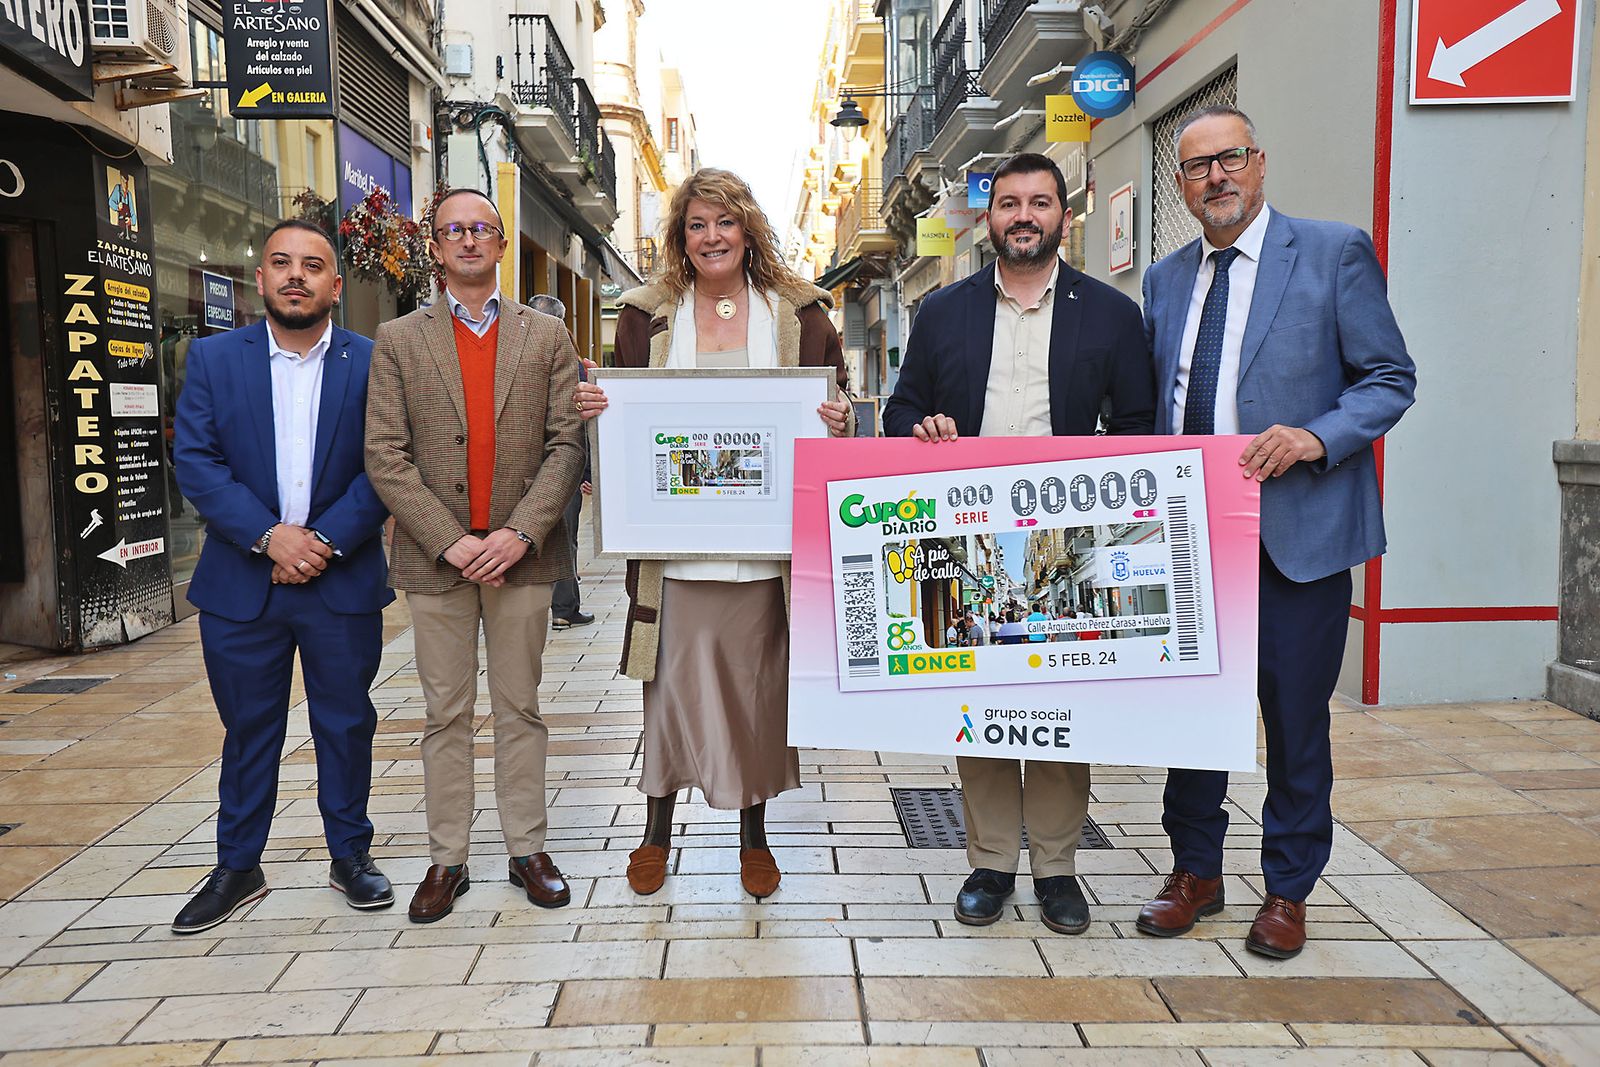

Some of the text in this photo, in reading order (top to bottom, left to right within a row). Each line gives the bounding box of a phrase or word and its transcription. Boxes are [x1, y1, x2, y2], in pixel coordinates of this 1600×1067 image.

[233, 3, 252, 15] EL
[233, 14, 321, 33] ARTESANO
[246, 37, 310, 50] Arreglo y venta
[255, 51, 303, 61] del calzado
[246, 64, 313, 77] Artículos en piel
[1073, 78, 1130, 93] DIGI
[271, 92, 327, 103] EN GALERIA
[1052, 113, 1087, 123] Jazztel
[344, 160, 368, 191] Maribel
[96, 239, 149, 261] ZAPATERO
[87, 250, 152, 277] EL ARTESANO
[209, 281, 228, 297] PRECIOS
[207, 306, 233, 322] ESPECIALES
[63, 273, 109, 494] ZAPATERO
[692, 432, 708, 441] 000
[713, 432, 761, 446] 00000
[947, 465, 1193, 517] 000 00000 2€
[954, 510, 989, 525] SERIE
[119, 541, 159, 559] EN INTERIOR
[911, 545, 949, 566] A pie
[913, 562, 964, 582] de calle
[1133, 567, 1166, 577] HUELVA
[1027, 615, 1171, 633] Calle Arquitecto Pérez Carasa Huelva
[887, 620, 916, 651] 85
[913, 653, 971, 671] ONCE
[1048, 651, 1118, 668] 5 FEB. 24
[984, 707, 1072, 721] grupo social
[984, 723, 1071, 748] ONCE
